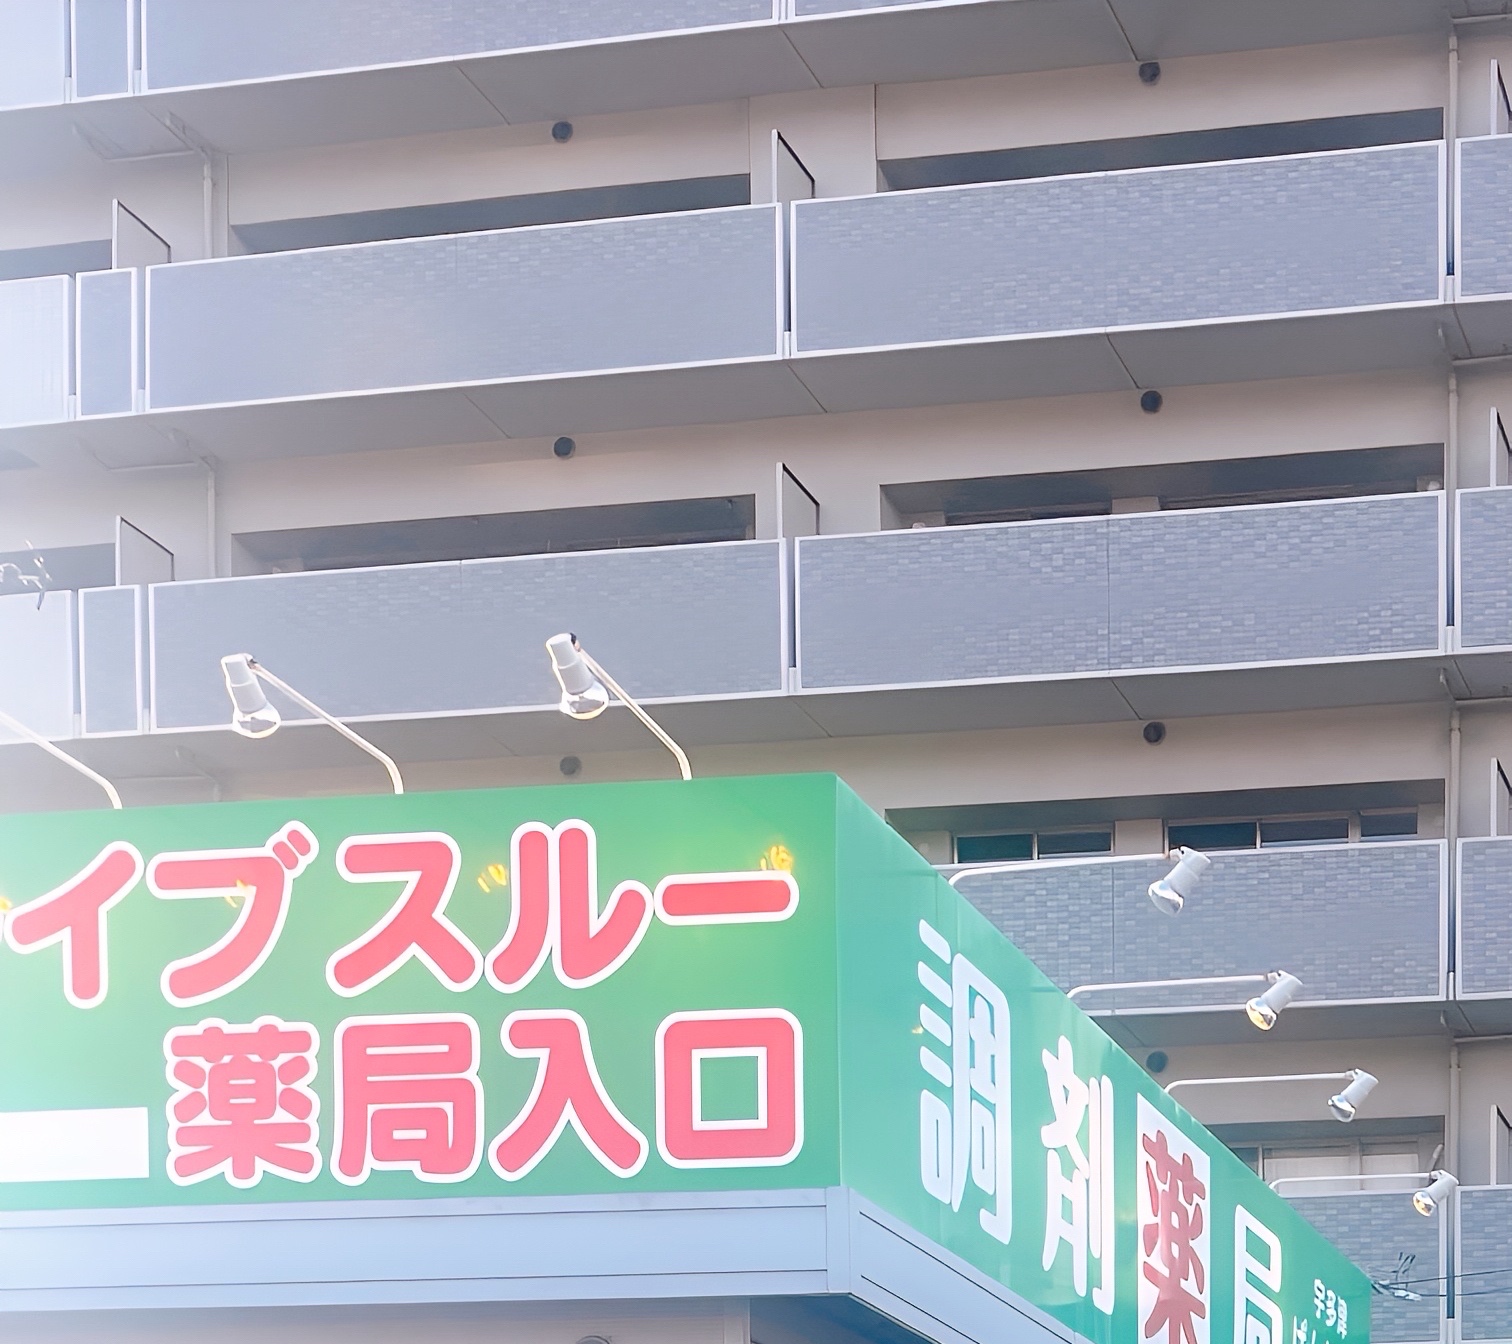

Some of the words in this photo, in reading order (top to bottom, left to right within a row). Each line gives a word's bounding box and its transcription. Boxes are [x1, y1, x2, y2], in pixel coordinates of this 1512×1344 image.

[4, 818, 799, 1008] イブスルー
[163, 1008, 803, 1188] 薬局入口
